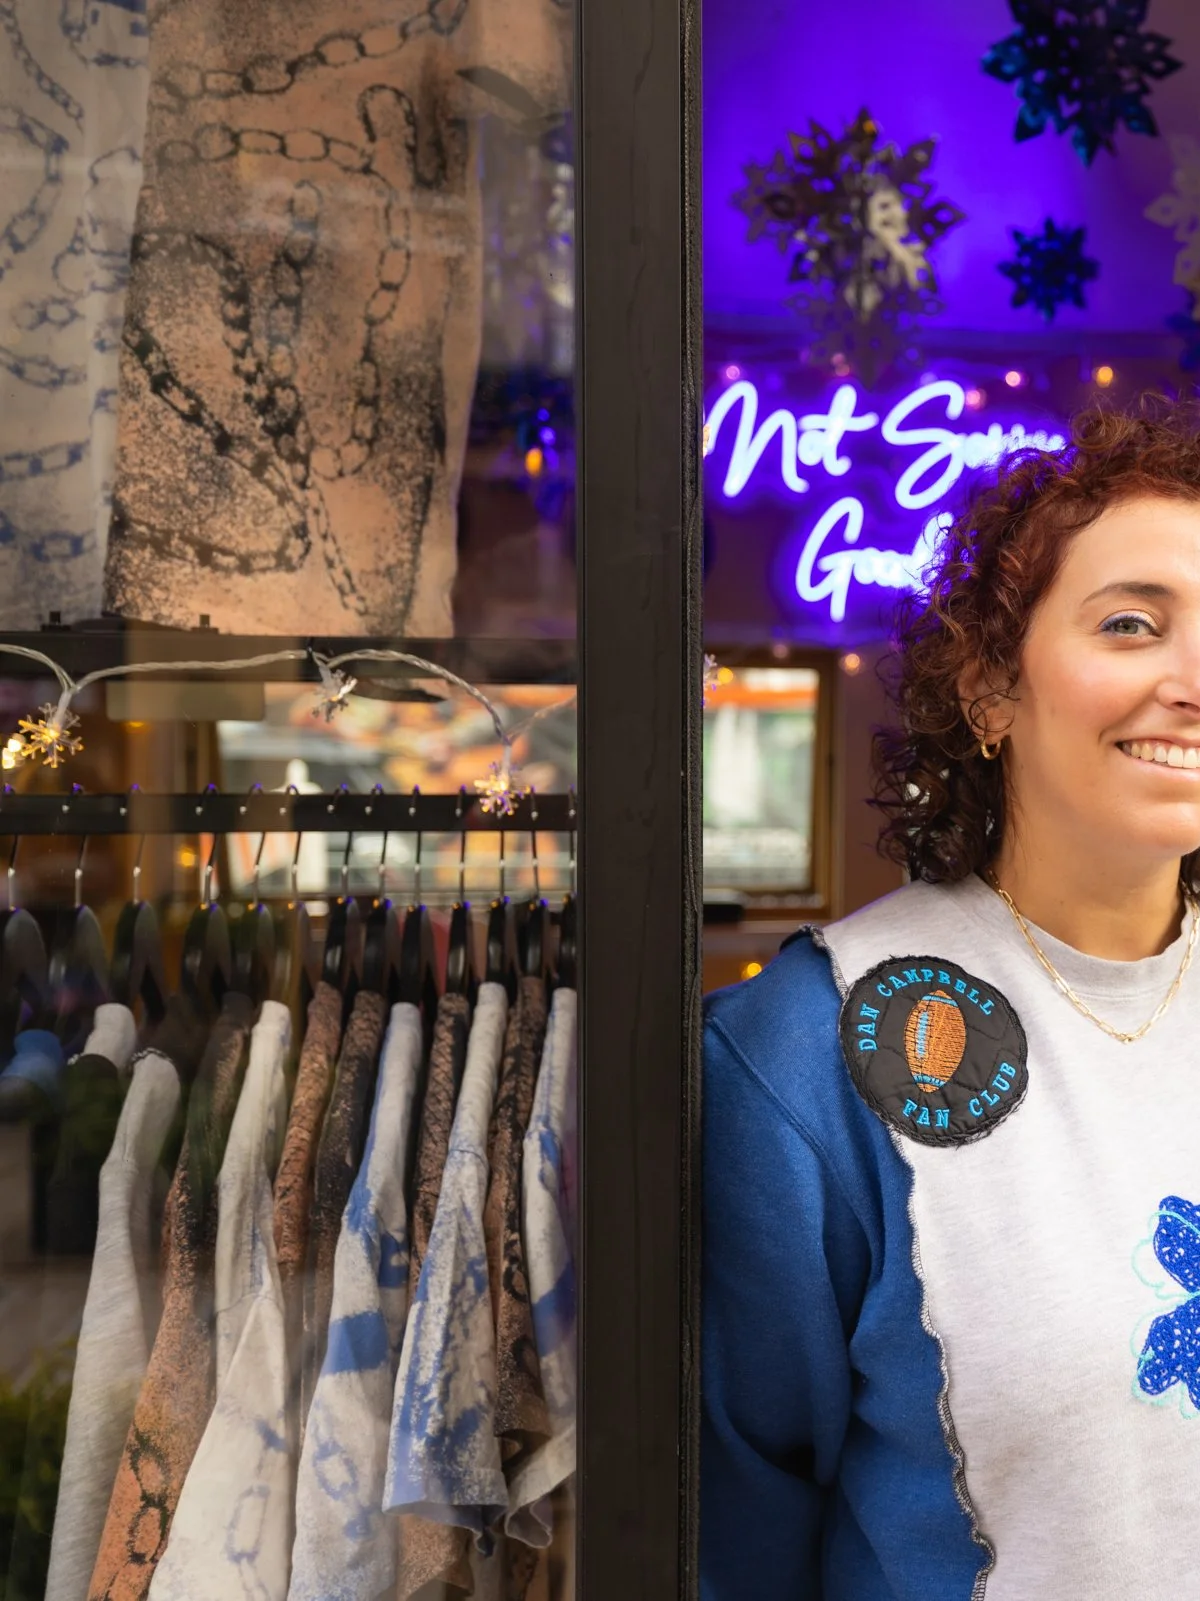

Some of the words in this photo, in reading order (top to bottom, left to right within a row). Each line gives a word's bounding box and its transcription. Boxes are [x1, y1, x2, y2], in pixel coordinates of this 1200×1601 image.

[702, 380, 879, 497] Not
[881, 380, 1066, 510] Sorr
[857, 1002, 880, 1053] DAN
[876, 968, 995, 1016] CAMPBELL
[902, 1098, 950, 1128] FAN
[968, 1062, 1016, 1117] CLUB
